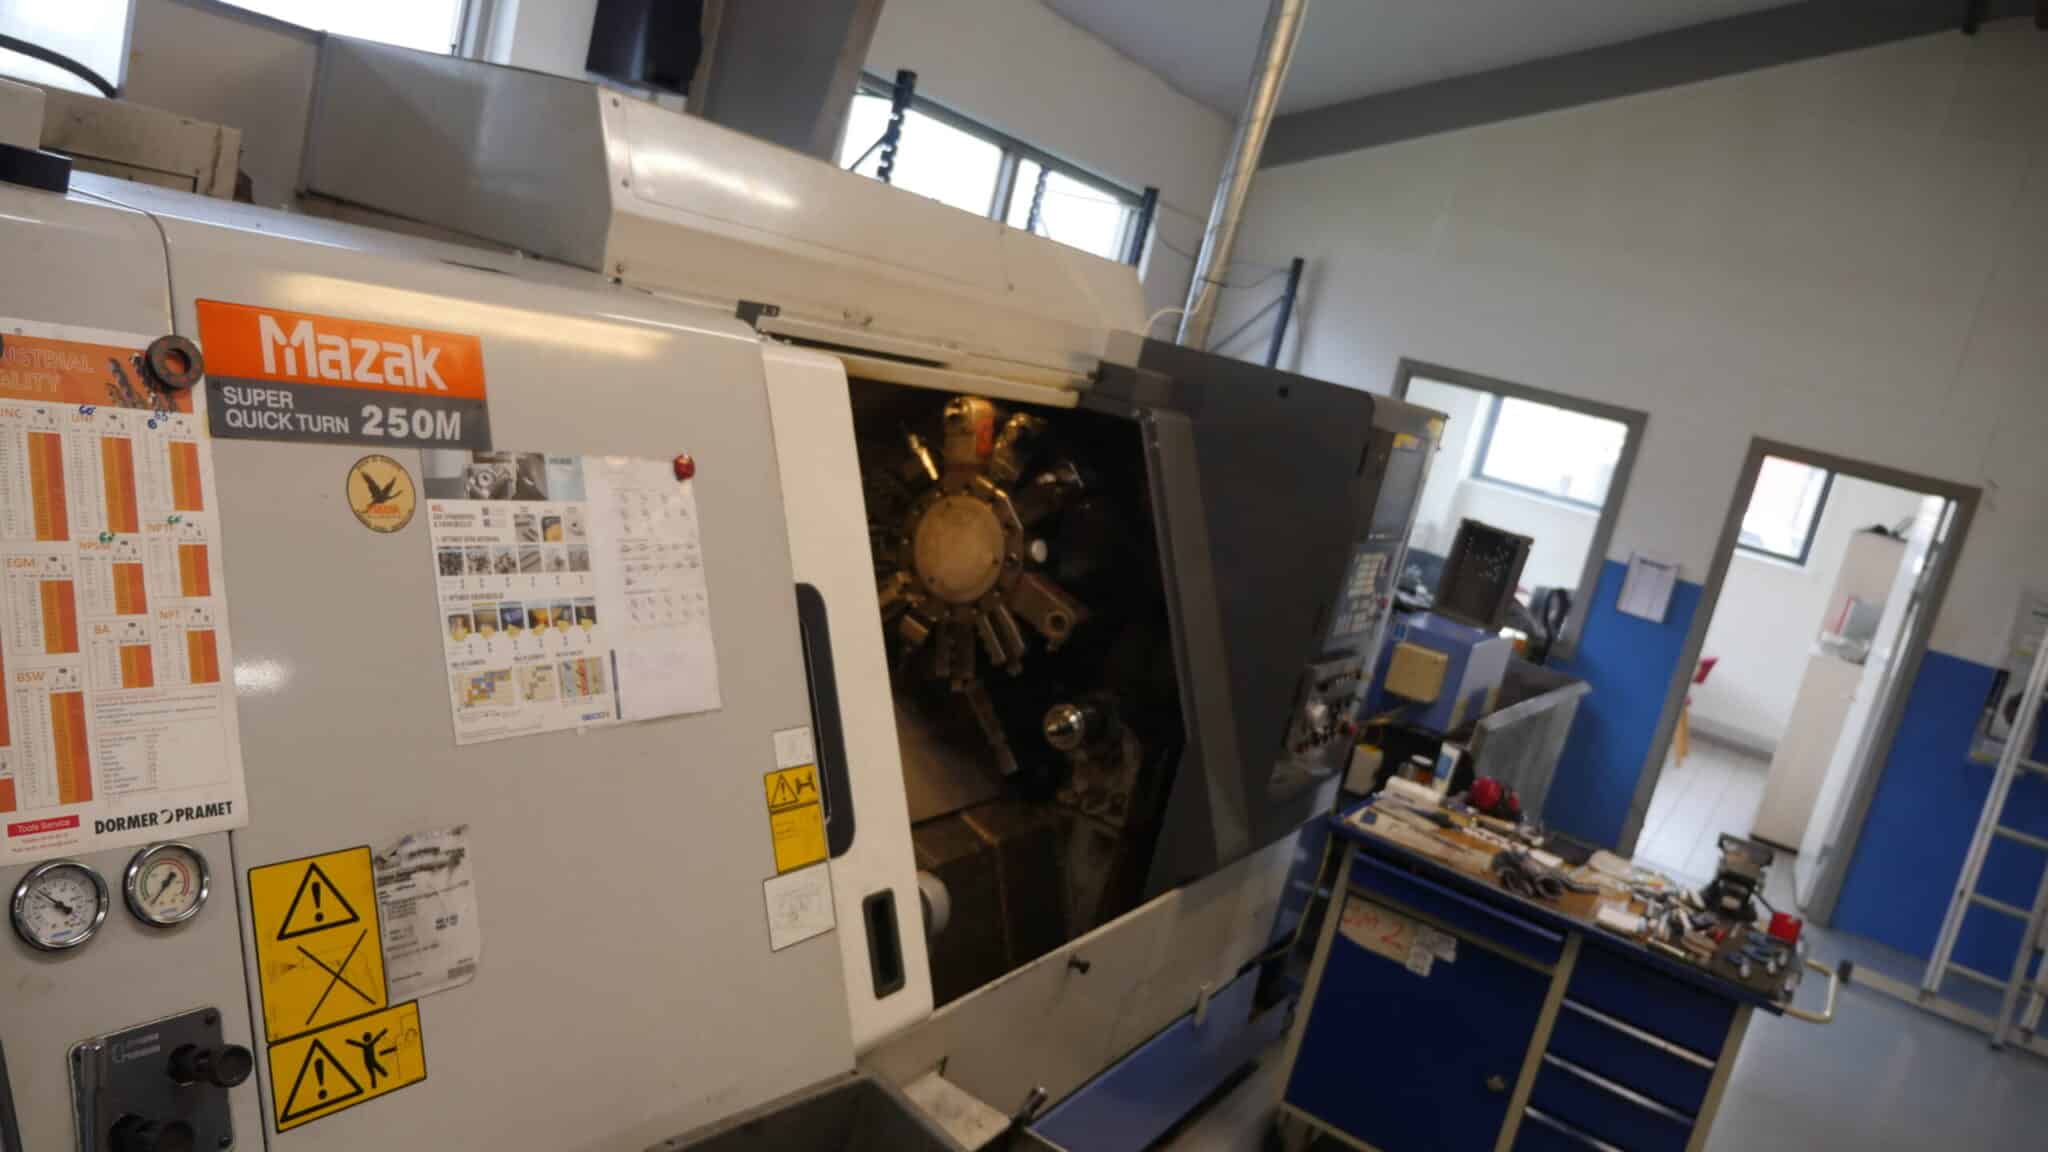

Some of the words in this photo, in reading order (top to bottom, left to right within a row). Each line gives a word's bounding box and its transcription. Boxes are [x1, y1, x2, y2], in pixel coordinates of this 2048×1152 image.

[258, 314, 448, 390] Mazak
[222, 386, 294, 409] SUPER
[225, 408, 293, 431] QUICK
[296, 413, 349, 434] TURN
[361, 405, 461, 440] 250M
[16, 671, 46, 683] BSW
[94, 812, 159, 835] DORMER
[175, 801, 233, 824] PRAMET
